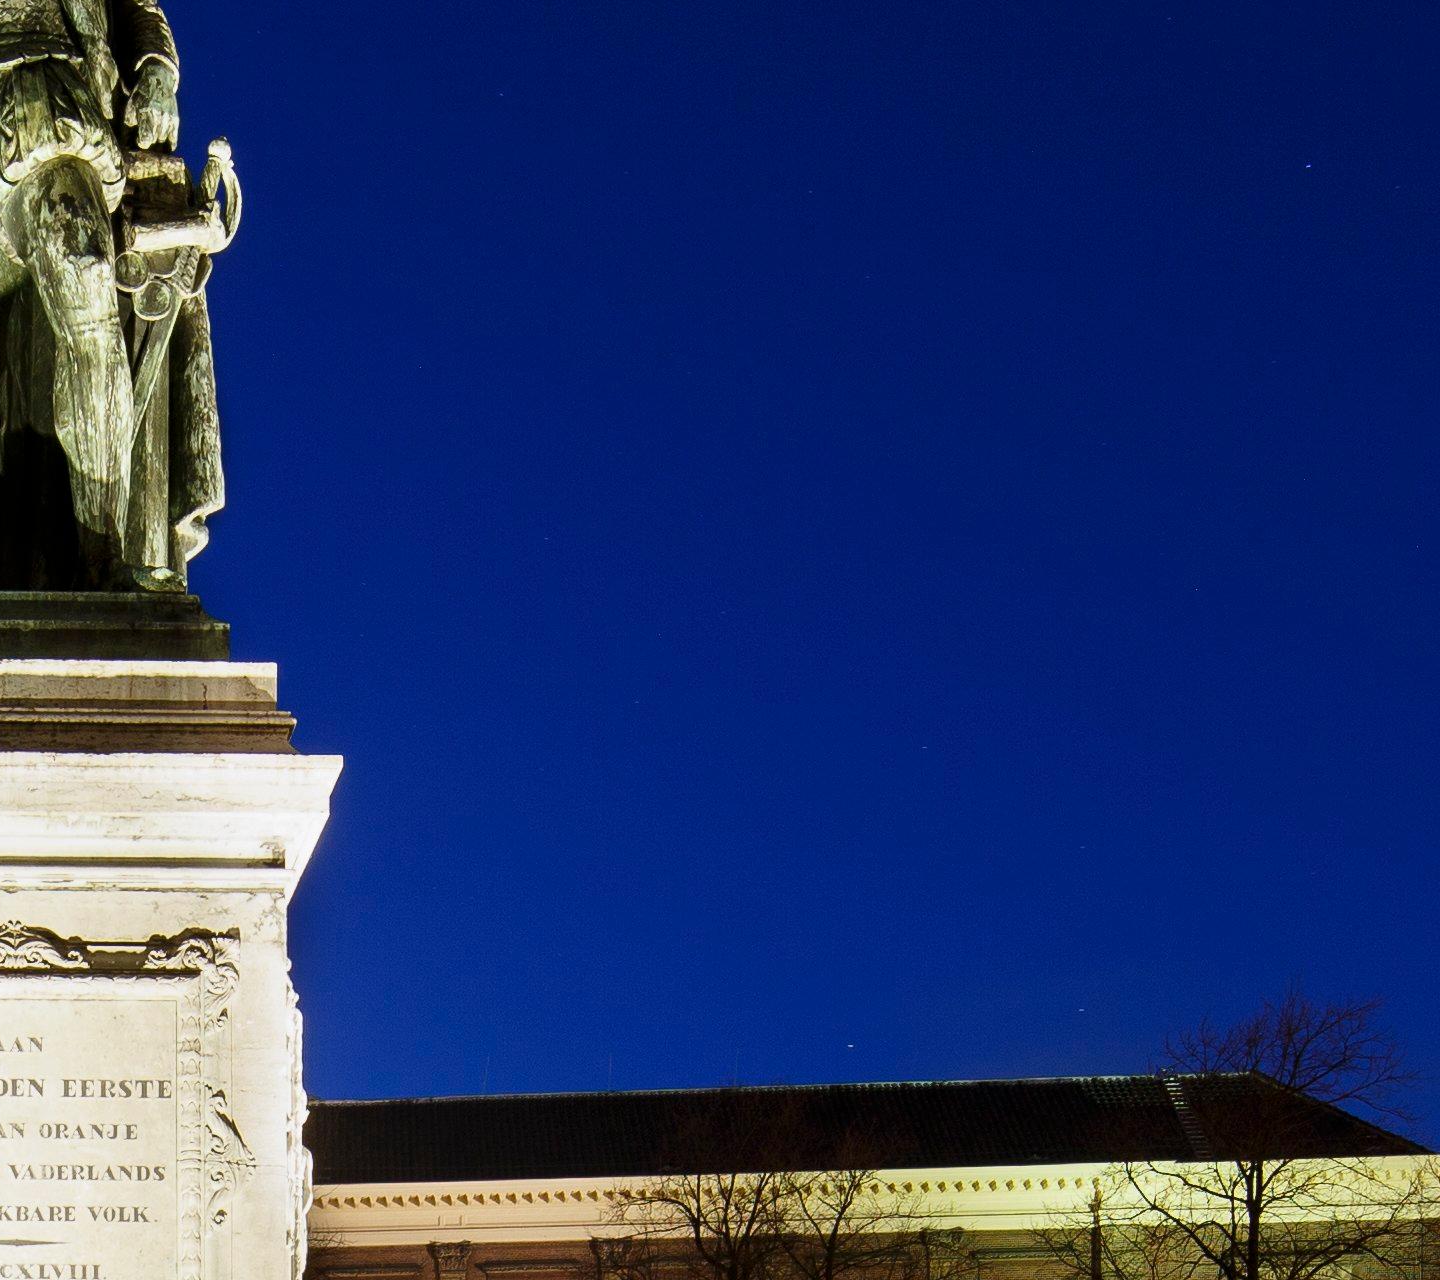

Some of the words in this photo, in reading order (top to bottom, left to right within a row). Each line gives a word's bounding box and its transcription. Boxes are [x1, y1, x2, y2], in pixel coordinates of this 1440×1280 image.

[61, 1079, 172, 1098] EERSTE
[39, 1123, 137, 1140] ORANJE
[8, 1164, 165, 1181] VADERLANDS
